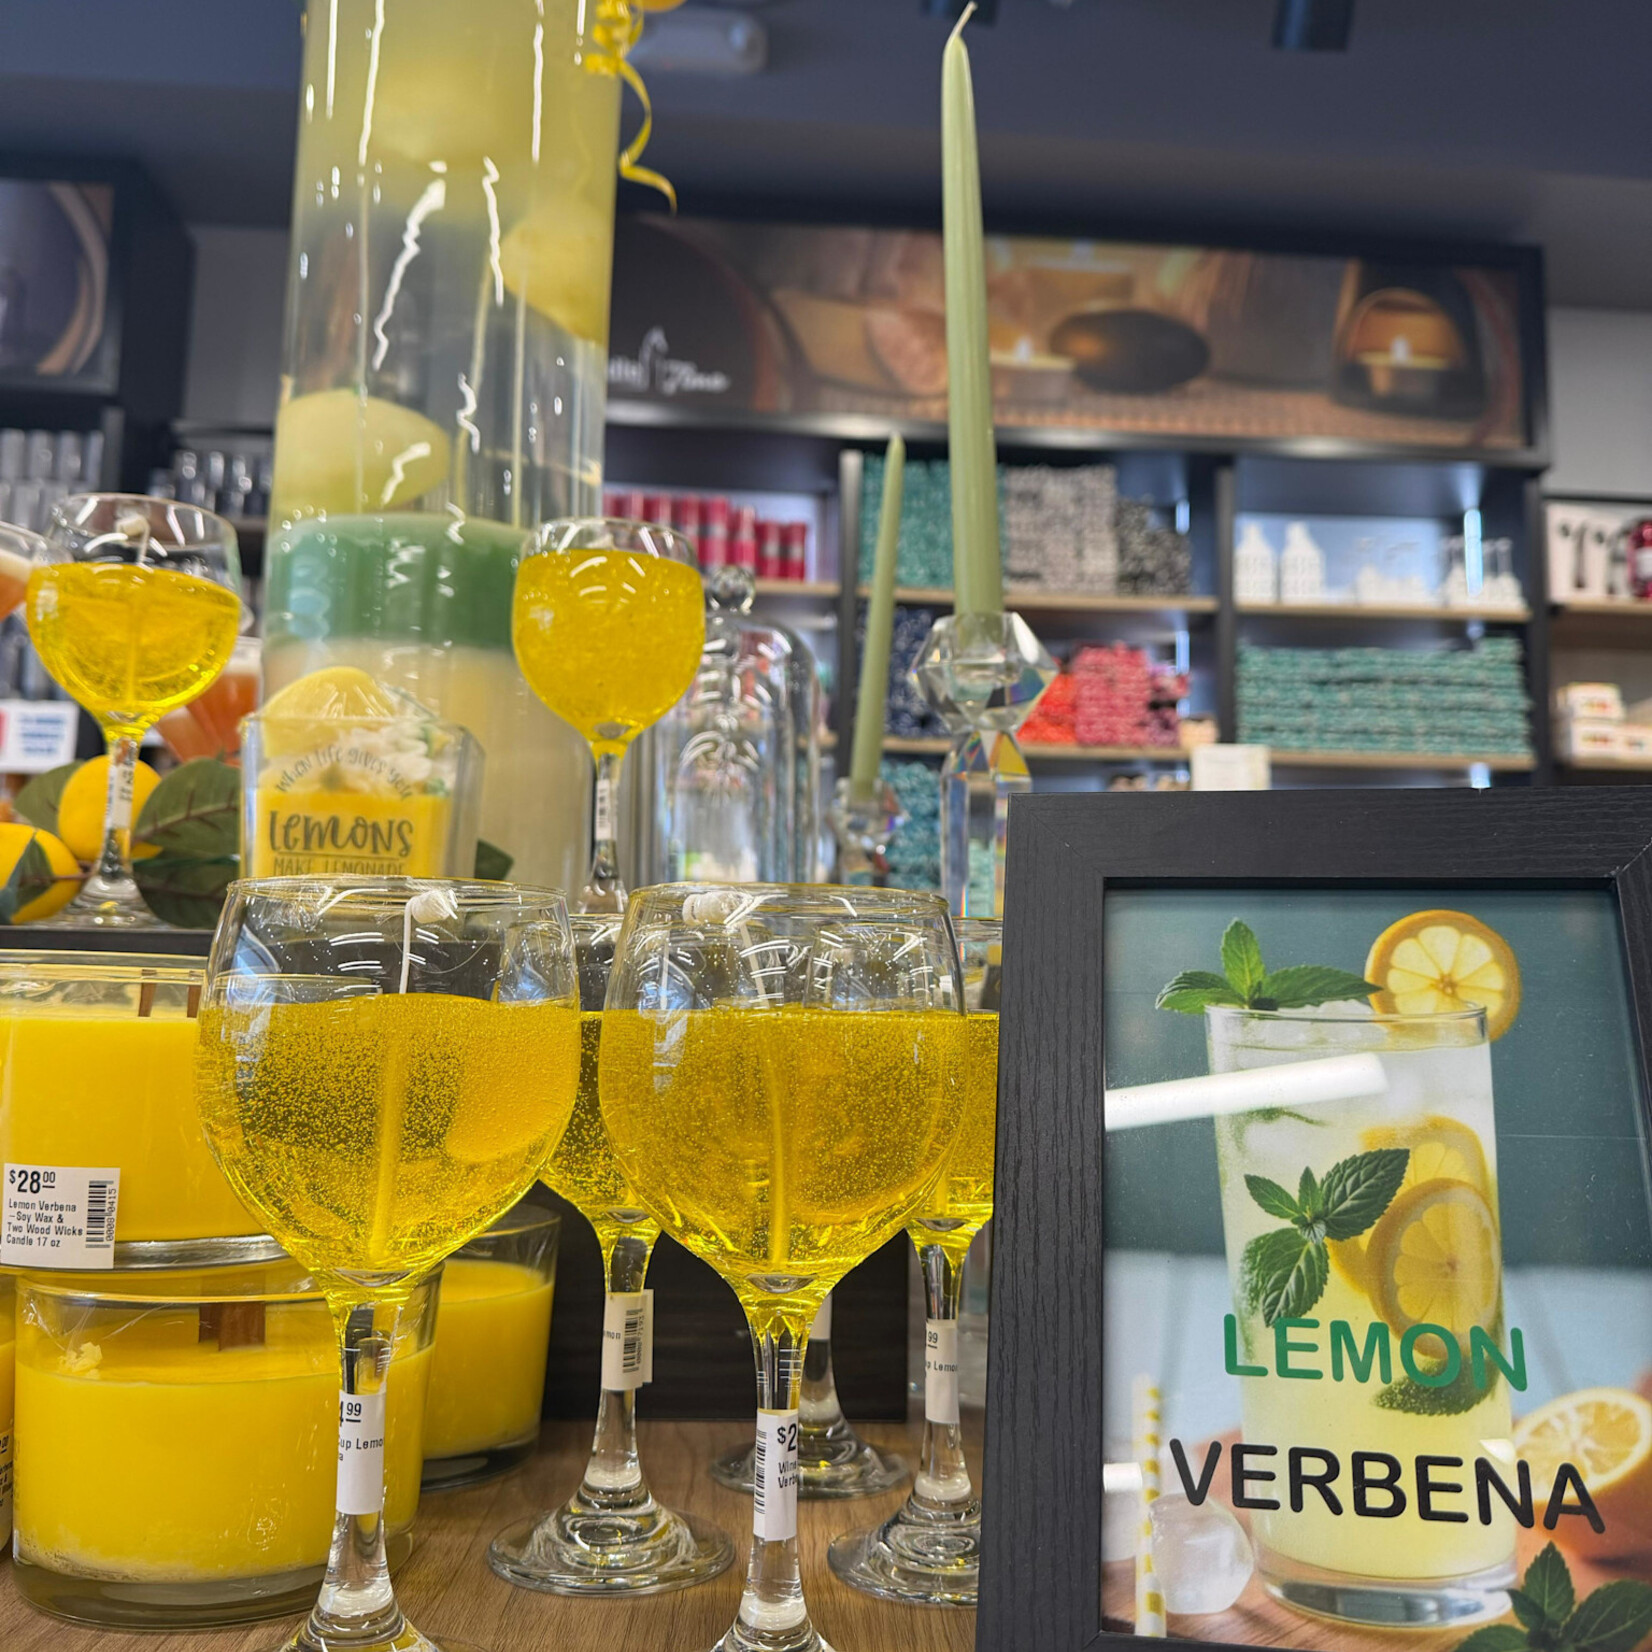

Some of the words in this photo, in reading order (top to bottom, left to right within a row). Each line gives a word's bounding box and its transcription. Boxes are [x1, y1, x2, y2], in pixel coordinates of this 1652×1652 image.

[9, 1198, 36, 1210] Lemon
[39, 1200, 77, 1212] Verbena
[35, 1213, 54, 1223] Wax
[56, 1214, 64, 1223] &
[7, 1222, 23, 1233] Two
[26, 1224, 51, 1235] Wood
[55, 1226, 83, 1236] Wicks
[6, 1234, 33, 1246] Candle
[37, 1237, 48, 1246] 17
[50, 1239, 60, 1247] oz
[1223, 1313, 1528, 1392] LEMON
[339, 1437, 352, 1451] up
[1169, 1438, 1606, 1534] VERBENA
